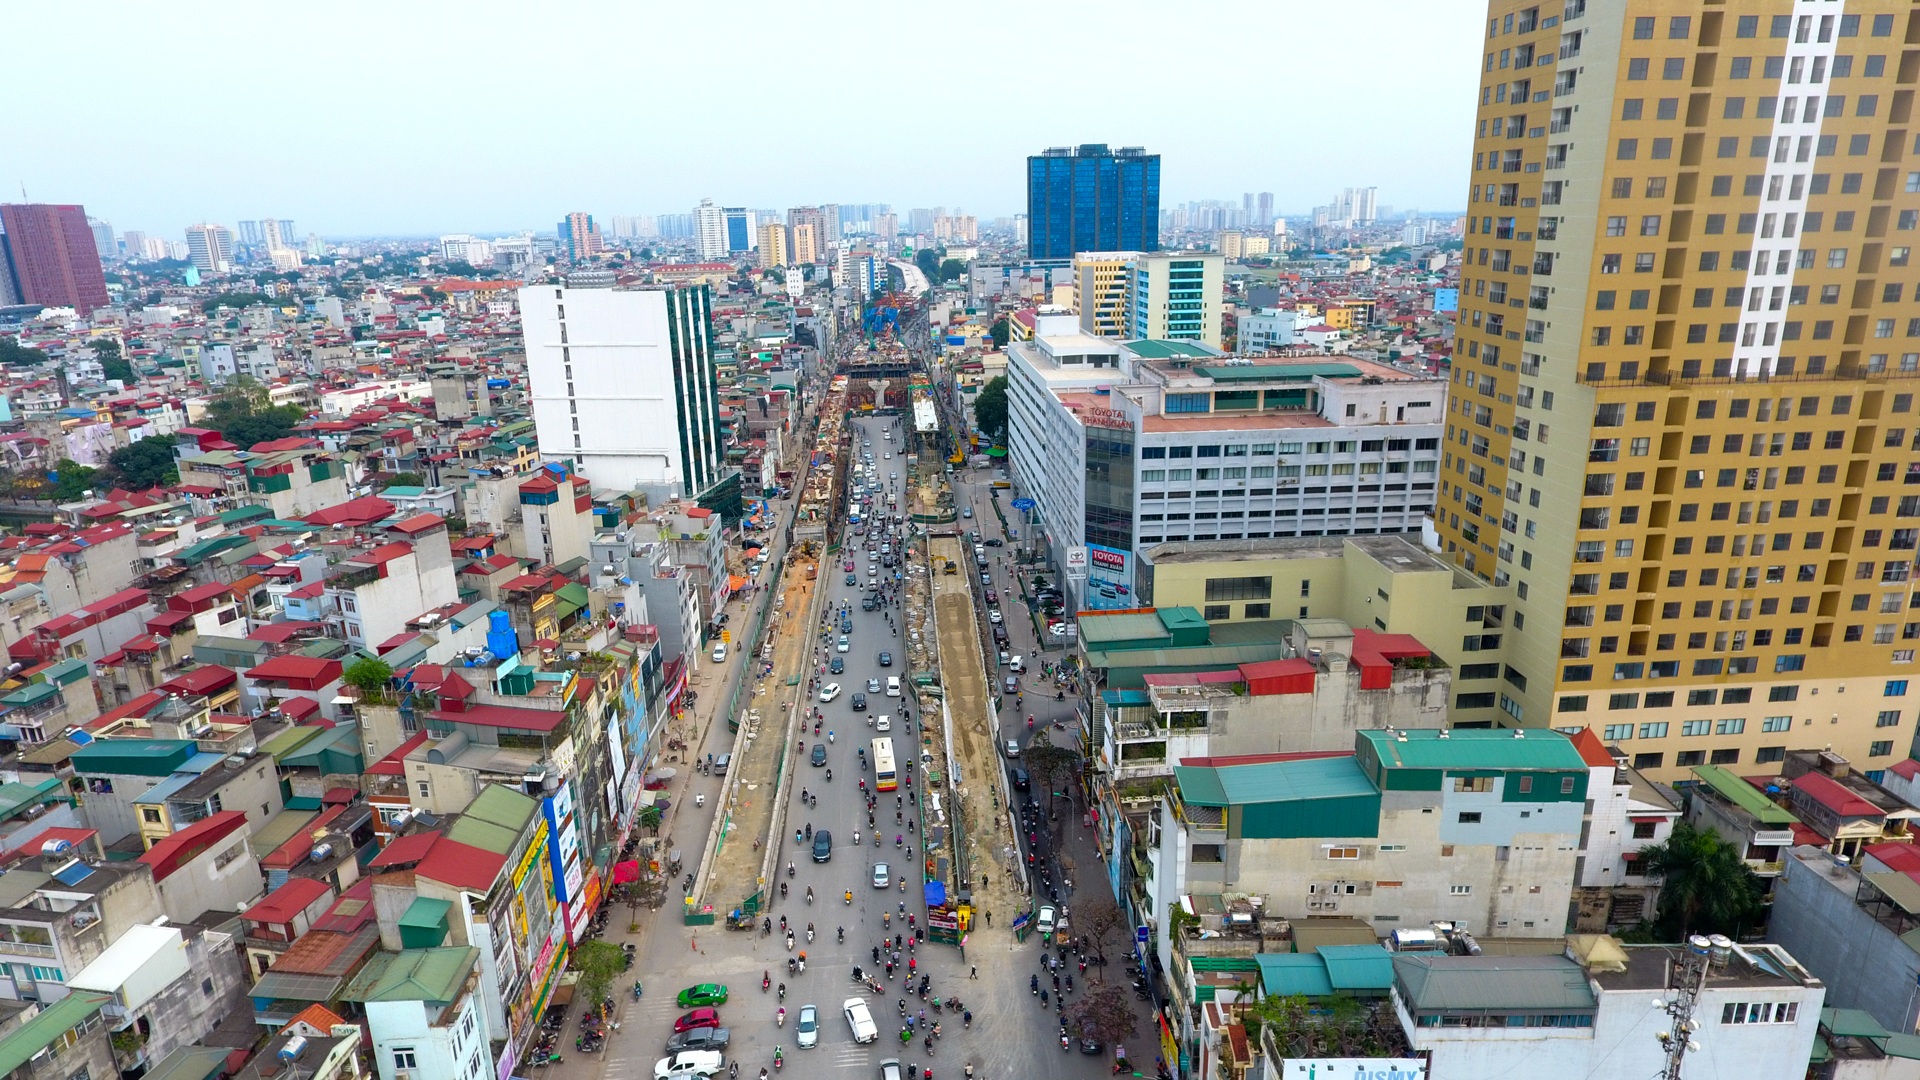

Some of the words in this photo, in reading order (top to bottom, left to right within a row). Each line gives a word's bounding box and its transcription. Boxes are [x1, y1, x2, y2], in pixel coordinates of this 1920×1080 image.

[1090, 408, 1123, 418] TOYOTA
[1083, 416, 1109, 426] THANH
[1093, 550, 1123, 564] TOYOTA
[1093, 560, 1109, 569] THANH
